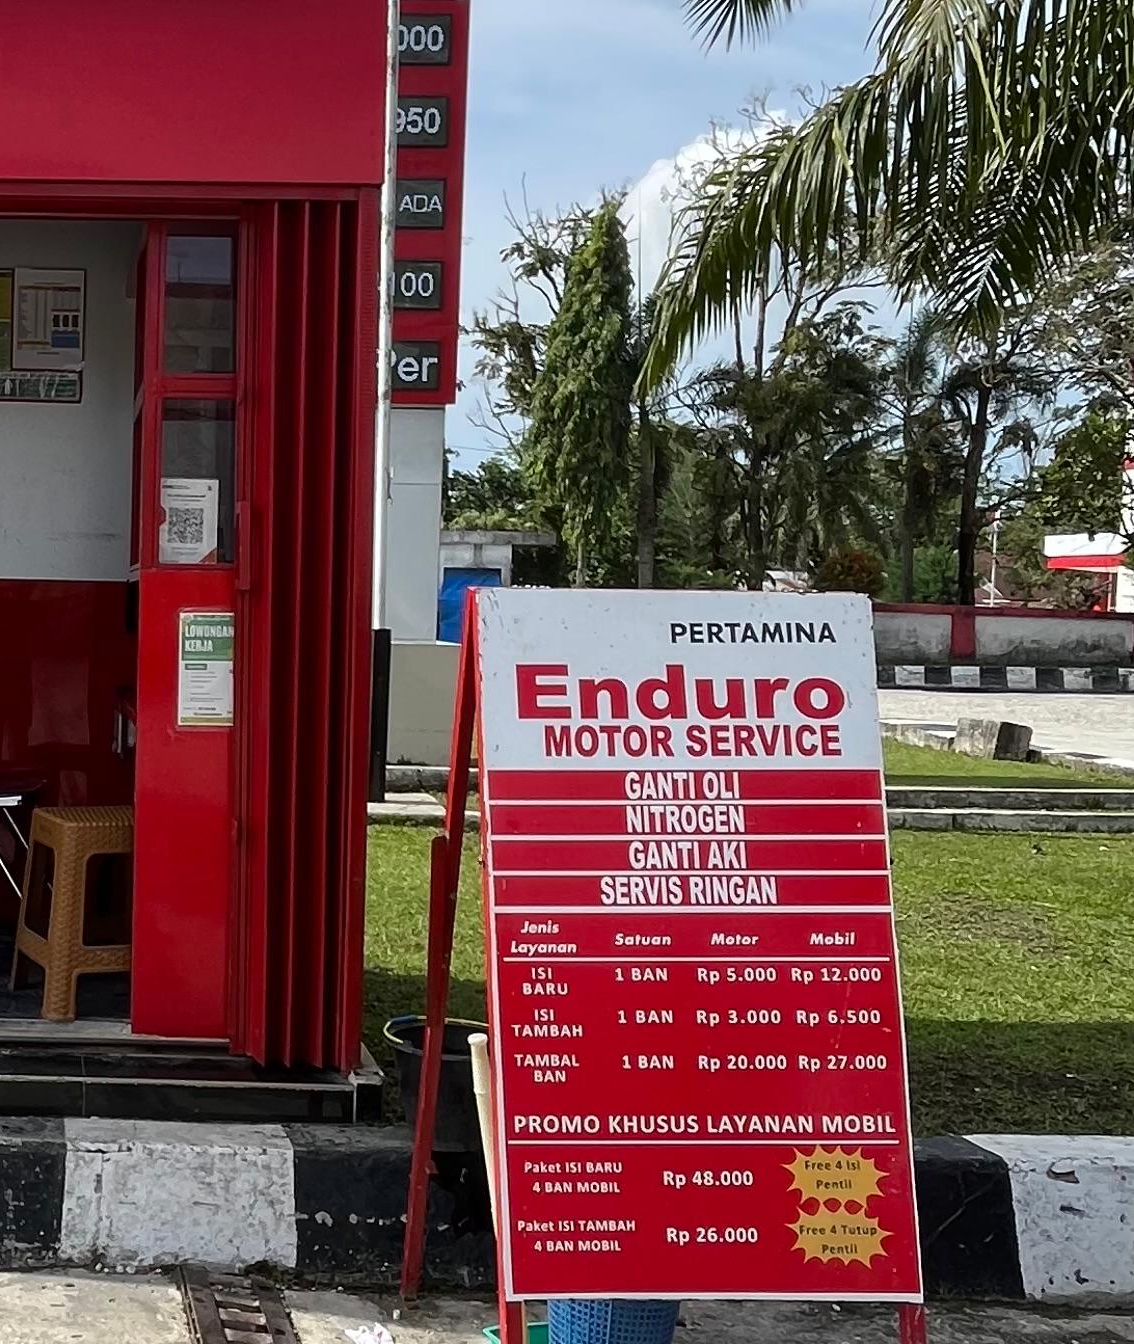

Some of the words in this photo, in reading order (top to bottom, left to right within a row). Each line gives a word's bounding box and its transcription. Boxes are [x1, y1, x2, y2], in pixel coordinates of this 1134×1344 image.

[399, 195, 442, 213] ADA
[185, 625, 234, 638] LOWONGAN
[670, 622, 837, 644] PERTAMINA
[185, 639, 213, 652] KERJA
[515, 664, 845, 720] Enduro
[544, 724, 673, 757] MOTOR
[686, 724, 842, 757] SERVICE
[625, 771, 696, 800] GANTI
[702, 771, 740, 799] OLI
[626, 805, 745, 833] NITROGEN
[629, 841, 701, 870] GANTI
[707, 841, 747, 869] AKI
[600, 876, 684, 905] SERVIS
[689, 875, 778, 905] RINGAN
[520, 920, 560, 934] Jenis
[615, 933, 672, 946] Satuan
[711, 933, 759, 945] Motor
[809, 932, 855, 945] Mobil
[510, 941, 577, 956] Layanan
[531, 967, 552, 979] ISI
[615, 967, 624, 981] 1
[631, 967, 668, 981] BAN
[697, 968, 720, 984] Rp
[726, 968, 777, 982] 5.000
[791, 968, 814, 984] Rp
[820, 968, 882, 982] 12.000
[522, 983, 568, 995] BARU
[534, 1009, 554, 1021] ISI
[617, 1010, 627, 1023] 1
[635, 1010, 673, 1023] BAN
[696, 1010, 720, 1026] Rp
[728, 1010, 781, 1024] 3.000
[796, 1010, 819, 1026] Rp
[828, 1010, 881, 1024] 6.500
[511, 1024, 583, 1037] TAMBAH
[514, 1054, 580, 1067] TAMBAL
[622, 1055, 631, 1069] 1
[638, 1055, 674, 1069] BAN
[698, 1055, 720, 1072] Rp
[727, 1055, 787, 1069] 20.000
[798, 1055, 820, 1072] Rp
[827, 1055, 887, 1069] 27.000
[534, 1070, 566, 1083] BAN
[514, 1115, 600, 1133] PROMO
[608, 1115, 699, 1133] KHUSUS
[706, 1115, 814, 1133] LAYANAN
[822, 1115, 896, 1133] MOBIL
[524, 1161, 562, 1173] Paket
[565, 1162, 582, 1173] ISI
[586, 1162, 623, 1173] BARU
[804, 1160, 832, 1170] Free
[835, 1160, 843, 1170] 4
[663, 1171, 687, 1189] Rp
[692, 1171, 754, 1186] 48.000
[816, 1179, 852, 1189] Pentil
[532, 1182, 541, 1193] 4
[545, 1182, 573, 1193] BAN
[577, 1182, 621, 1193] MOBIL
[517, 1220, 555, 1232] Paket
[558, 1220, 575, 1231] ISI
[578, 1220, 636, 1231] TAMBAH
[799, 1224, 826, 1235] Free
[830, 1224, 838, 1235] 4
[841, 1225, 878, 1236] Tutup
[666, 1228, 690, 1246] Rp
[696, 1227, 758, 1243] 26.000
[534, 1240, 542, 1251] 4
[546, 1240, 574, 1251] BAN
[578, 1240, 621, 1252] MOBIL
[821, 1244, 858, 1254] Pentil
